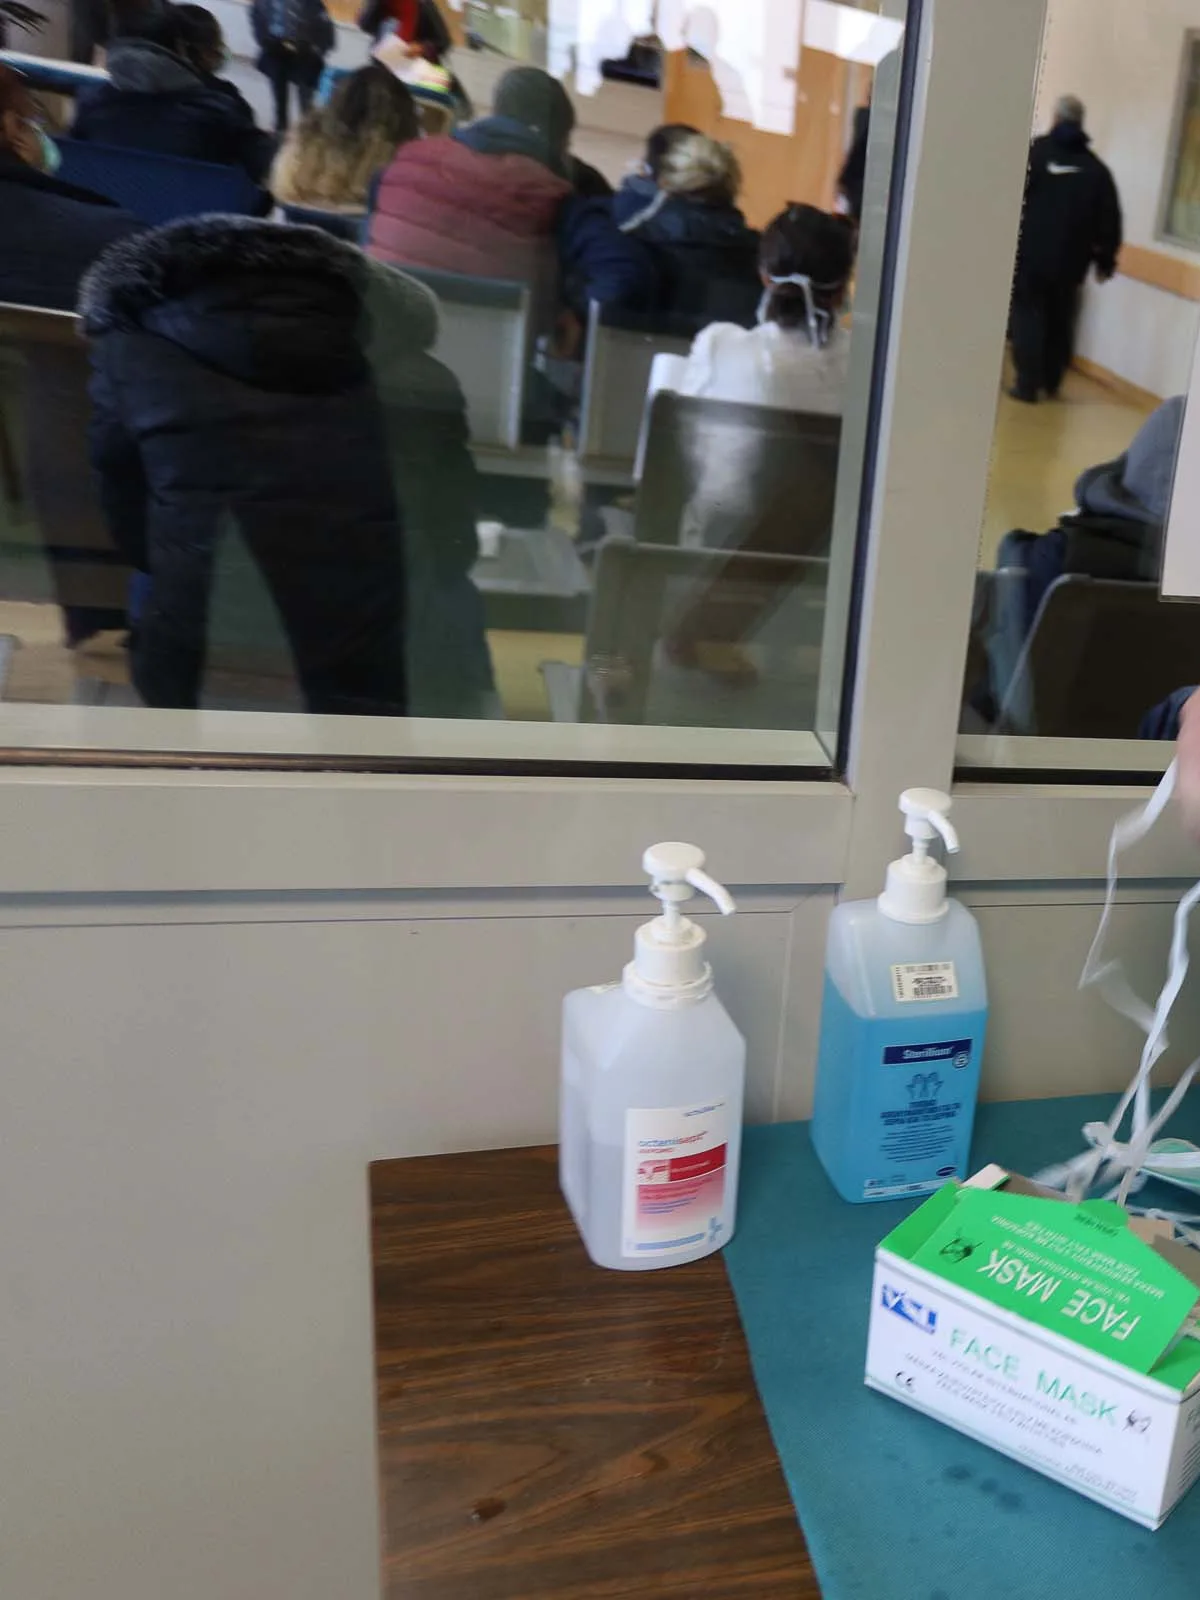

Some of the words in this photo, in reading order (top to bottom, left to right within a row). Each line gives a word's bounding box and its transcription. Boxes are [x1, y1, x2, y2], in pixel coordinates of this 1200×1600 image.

[976, 1249, 1062, 1304] MASK
[1060, 1288, 1142, 1341] FACE
[949, 1327, 1021, 1381] FACE
[1036, 1369, 1120, 1426] MASK
